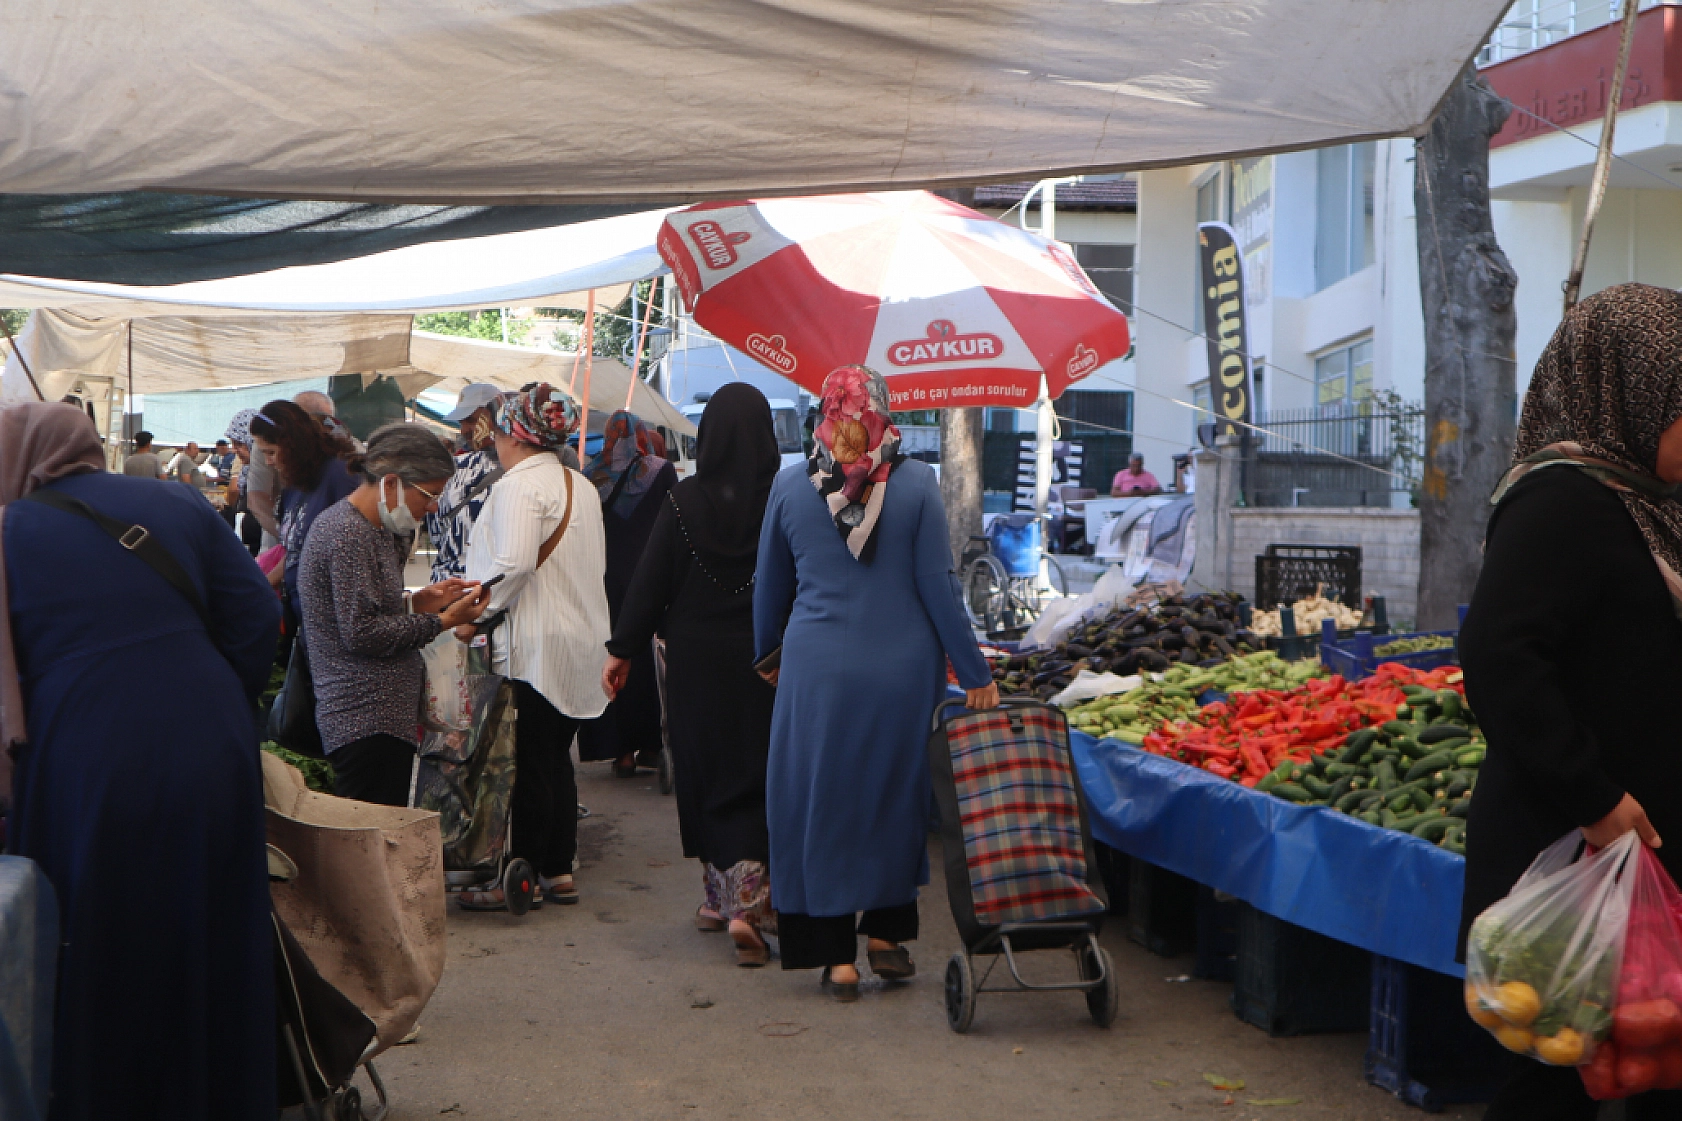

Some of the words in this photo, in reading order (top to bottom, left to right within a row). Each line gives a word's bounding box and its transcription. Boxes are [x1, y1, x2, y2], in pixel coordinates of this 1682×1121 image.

[1597, 66, 1650, 112] İŞ.
[895, 338, 995, 365] ÇAYKUR
[929, 387, 949, 402] çay
[987, 384, 1028, 397] sorulur
